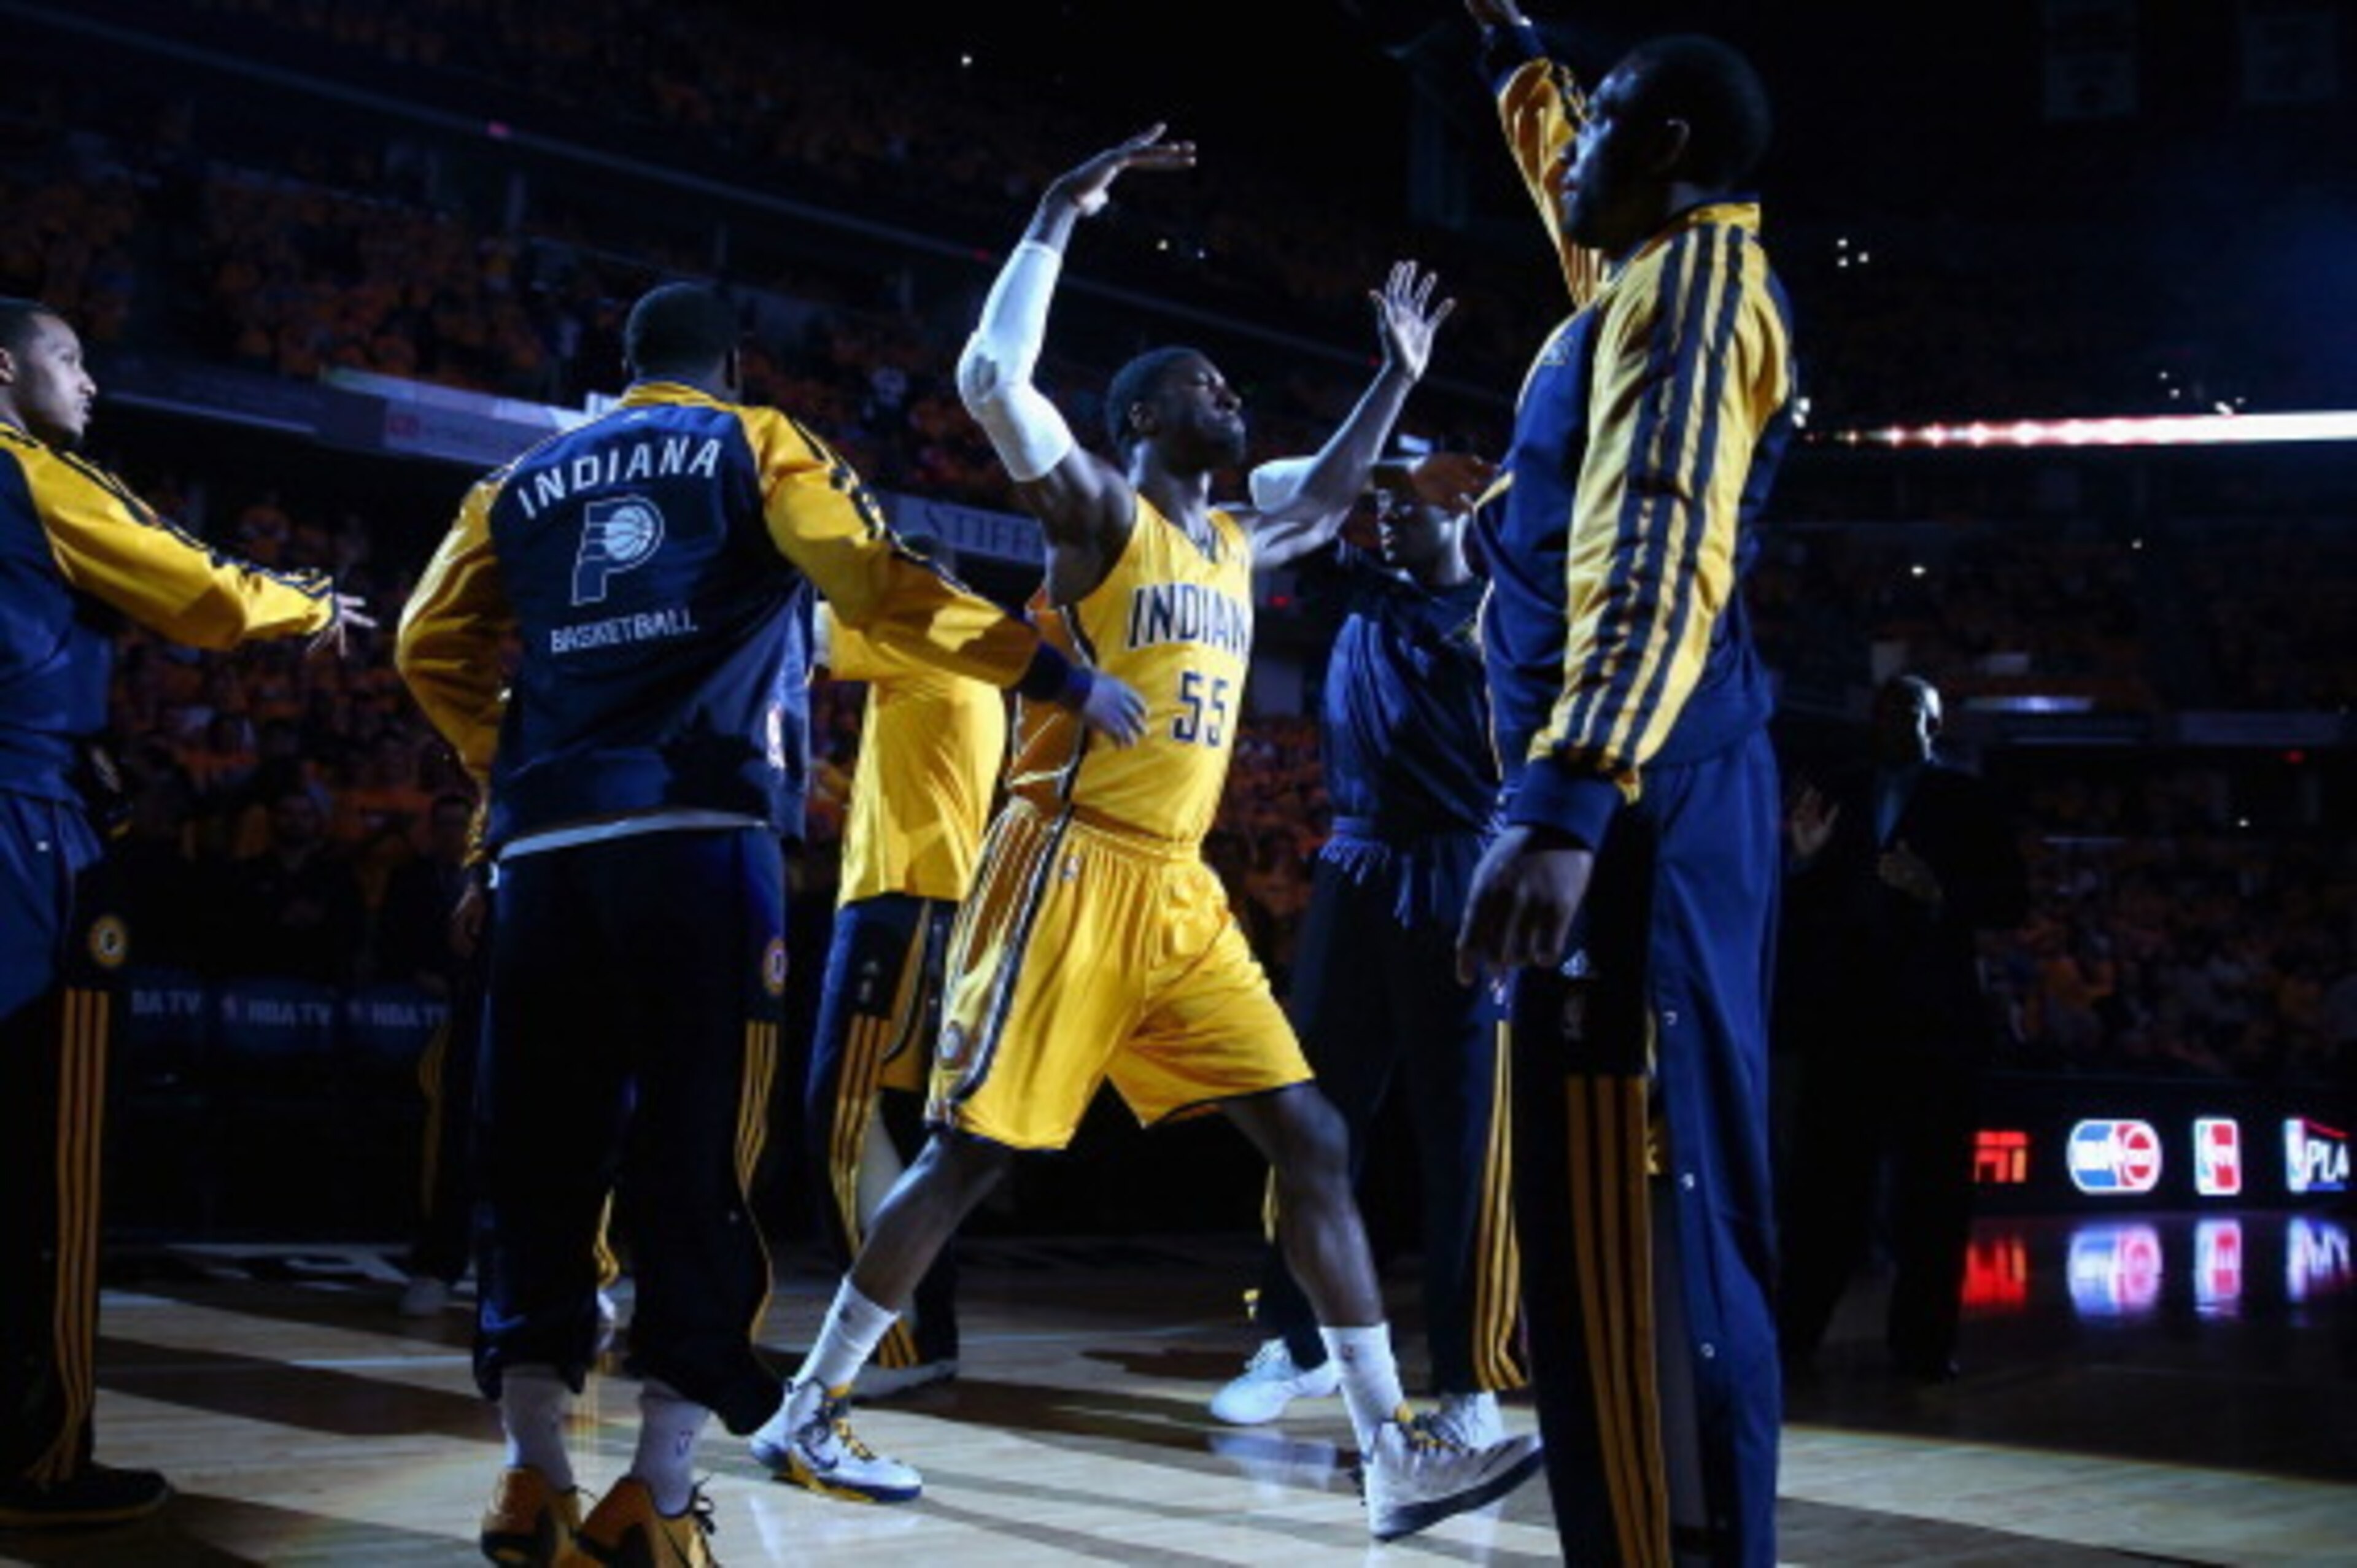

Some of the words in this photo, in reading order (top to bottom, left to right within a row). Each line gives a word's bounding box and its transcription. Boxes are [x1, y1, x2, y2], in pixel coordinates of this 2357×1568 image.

[517, 434, 721, 519] INDIANA
[550, 608, 699, 654] BASKETBALL
[1173, 670, 1229, 748] 55
